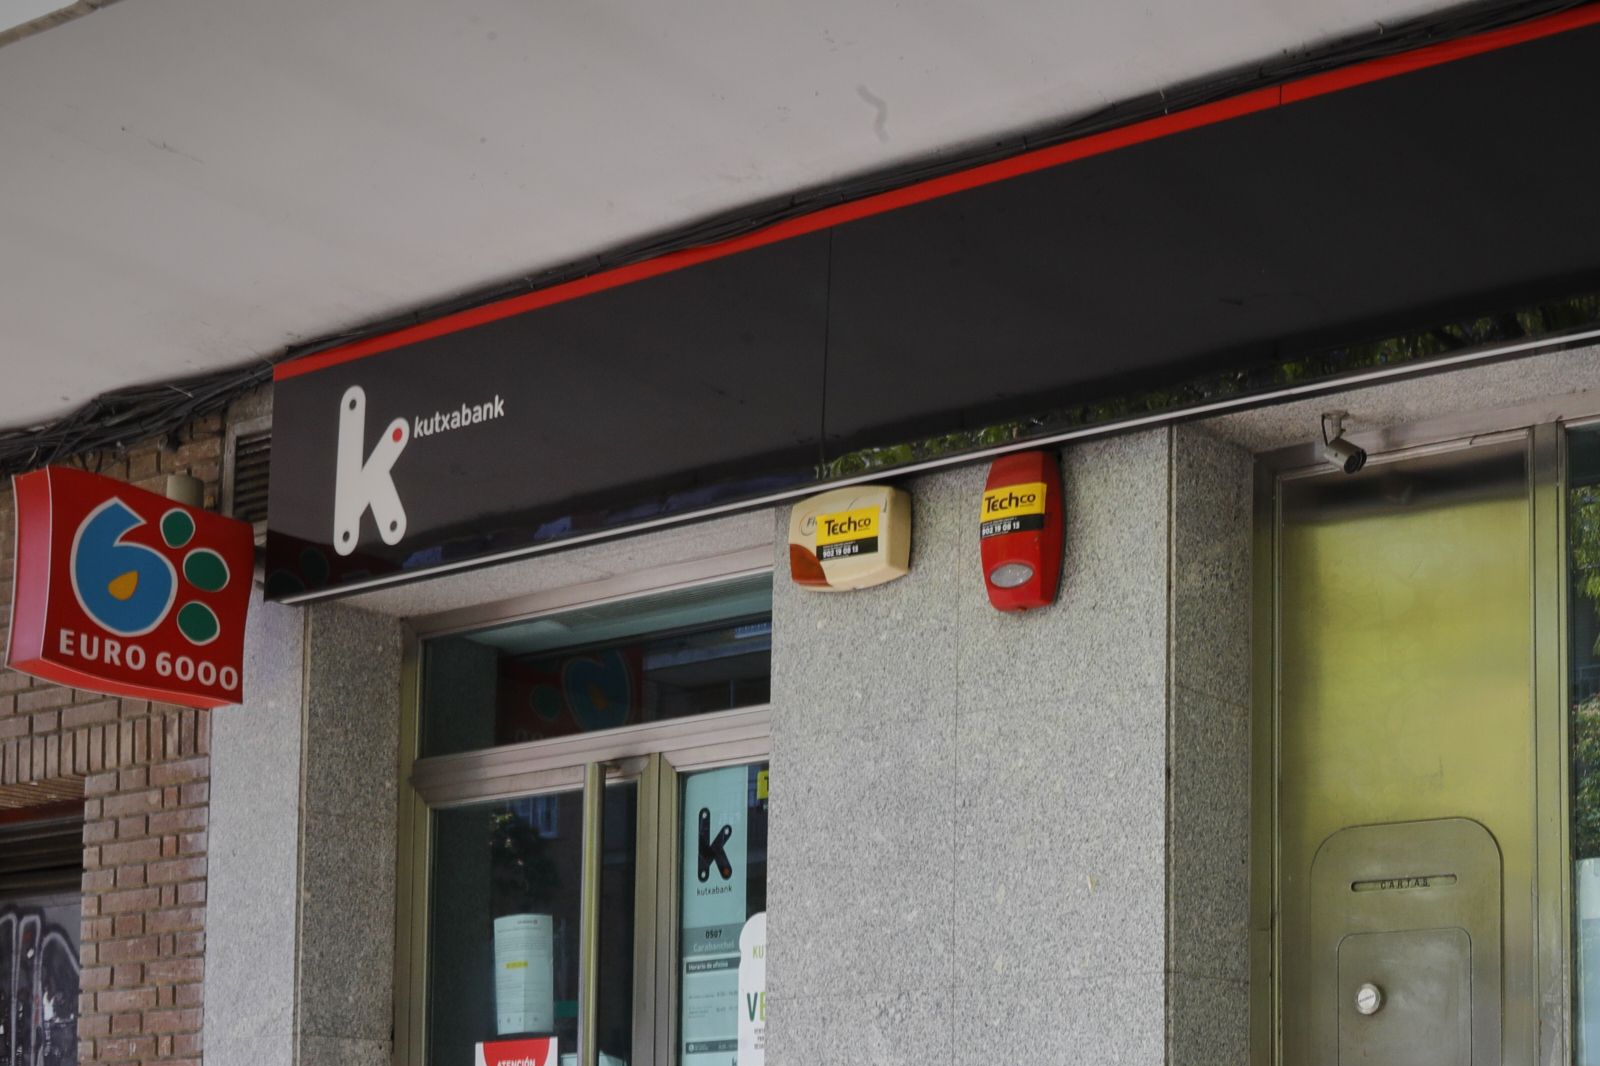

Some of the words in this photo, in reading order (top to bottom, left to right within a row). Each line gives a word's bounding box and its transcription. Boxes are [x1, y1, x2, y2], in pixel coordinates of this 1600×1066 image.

[413, 394, 505, 439] kutxabank
[985, 492, 1036, 513] Techco
[825, 516, 871, 537] Techco
[823, 550, 834, 559] 902
[59, 628, 146, 671] EURO
[155, 651, 239, 691] 6000
[696, 884, 733, 897] kutxabank
